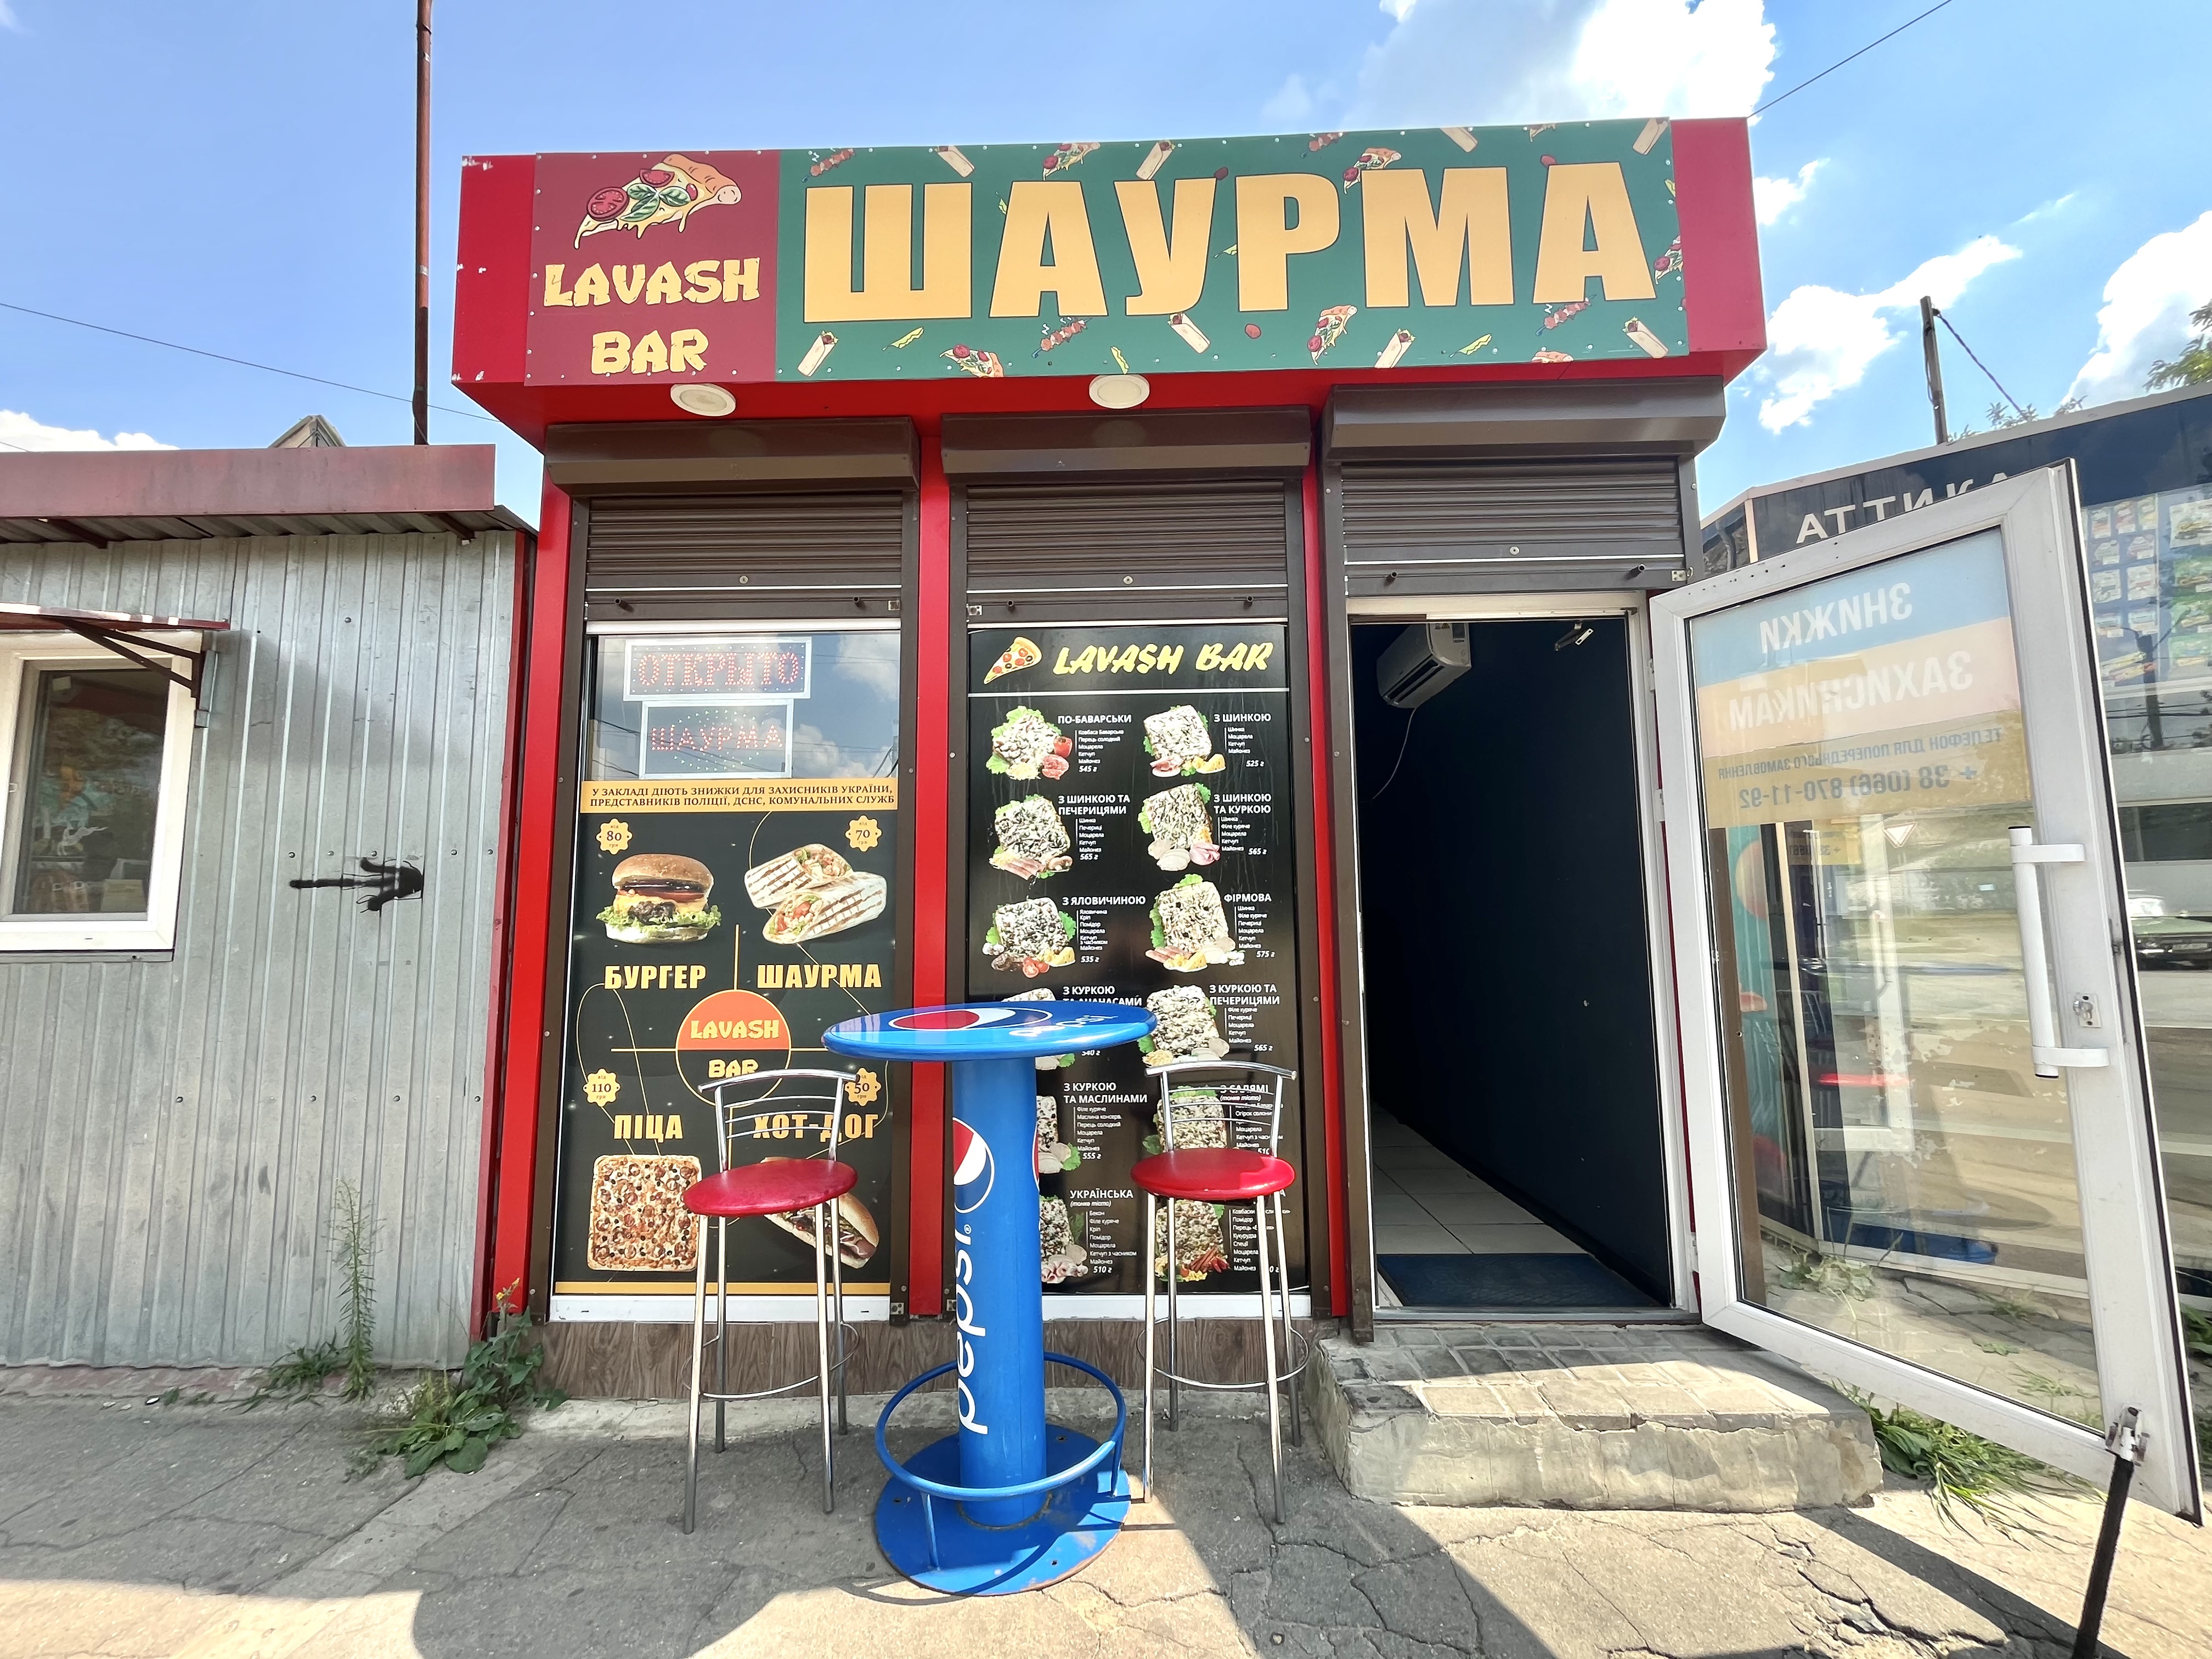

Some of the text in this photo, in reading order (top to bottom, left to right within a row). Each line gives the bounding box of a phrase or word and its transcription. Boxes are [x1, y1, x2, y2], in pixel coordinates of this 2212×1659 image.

[803, 161, 1657, 323] ШАУРМА
[543, 257, 760, 308] LAVASH
[591, 328, 708, 375] BAR
[1052, 642, 1273, 675] LAVASH BAR
[639, 652, 799, 686] ОТКРЫТО
[1058, 715, 1131, 724] ПО-БАВАРСЬКИ
[651, 724, 782, 752] ШАУРМА
[602, 788, 648, 797] ЗАКЛАДІ
[652, 788, 688, 797] ДІЮТЬ
[842, 785, 892, 794] УКРАЇНИ,
[590, 795, 894, 807] ПРЕДСТАВНИКІВ ПОЛІЦІЇ, ДСНС, КОМУНАЛЬНИХ СЛУЖБ
[1222, 794, 1272, 802] ШИНКОЮ
[1059, 806, 1126, 816] ПЕЧЕРИЦЯМИ
[1214, 805, 1271, 814] ТА КУРКОЮ
[607, 831, 622, 841] 80
[856, 830, 870, 840] 70
[1071, 896, 1146, 905] ЯЛОВИЧИНОЮ
[1224, 894, 1272, 902] ФІРМОВА
[604, 966, 706, 990] БУРГЕР
[757, 964, 881, 988] ШАУРМА
[1073, 986, 1115, 995] КУРКОЮ
[1218, 984, 1262, 993] КУРКОЮ
[1263, 984, 1277, 992] ТА
[1210, 996, 1279, 1006] ПЕЧЕРИЦЯМИ
[690, 1019, 779, 1039] LAVASH
[709, 1059, 759, 1078] BAR
[592, 1084, 611, 1092] 110
[854, 1083, 870, 1093] 50
[1073, 1082, 1116, 1091] КУРКОЮ
[1063, 1094, 1148, 1104] ТА МАСЛИНАМИ
[613, 1115, 682, 1143] ПІЦА
[1070, 1188, 1133, 1199] УКРАЇНСЬКА
[955, 1228, 988, 1435] pepsi
